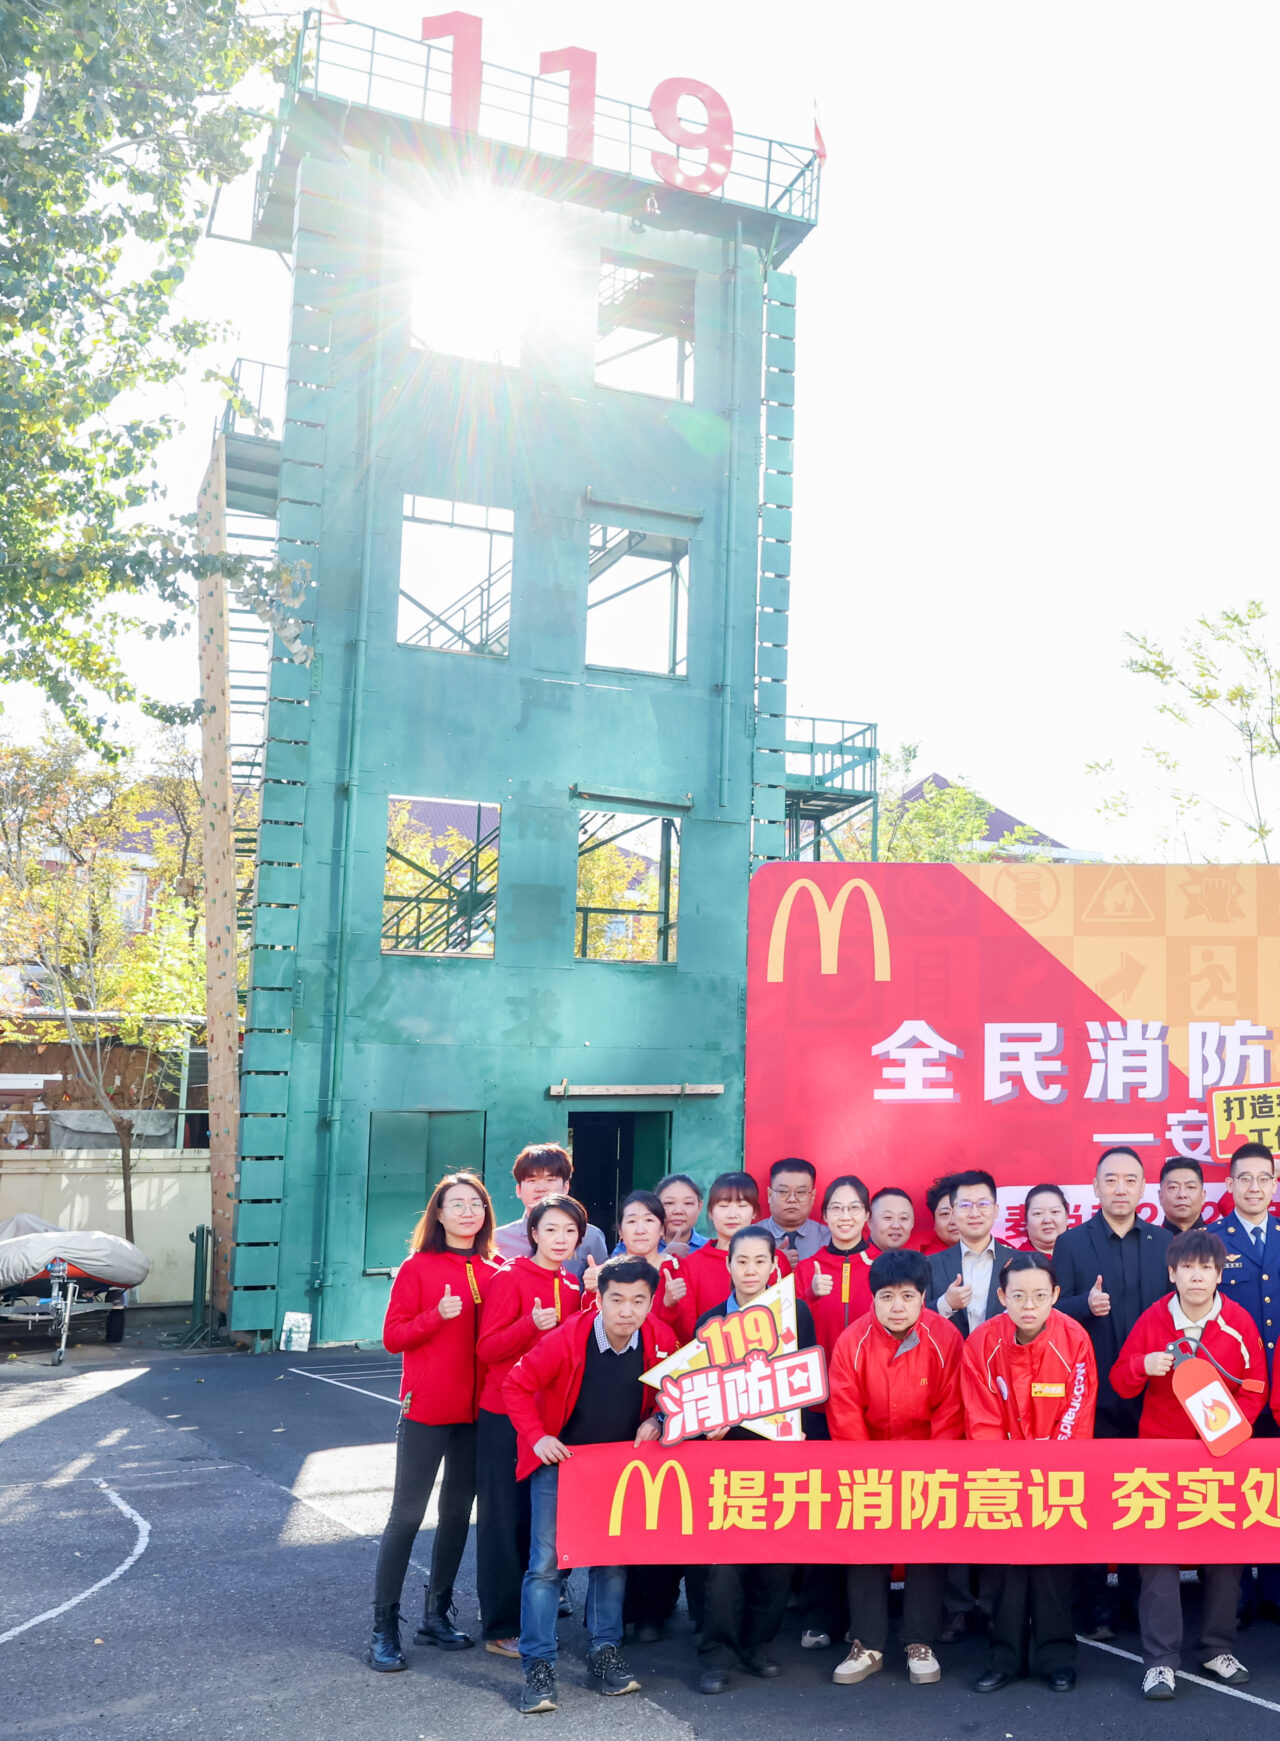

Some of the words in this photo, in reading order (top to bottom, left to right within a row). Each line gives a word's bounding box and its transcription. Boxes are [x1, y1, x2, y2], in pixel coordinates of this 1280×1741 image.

[421, 10, 734, 195] 119
[702, 1309, 772, 1365] 119
[660, 1350, 825, 1442] 消防日
[707, 1467, 1088, 1531] 提升消防意识
